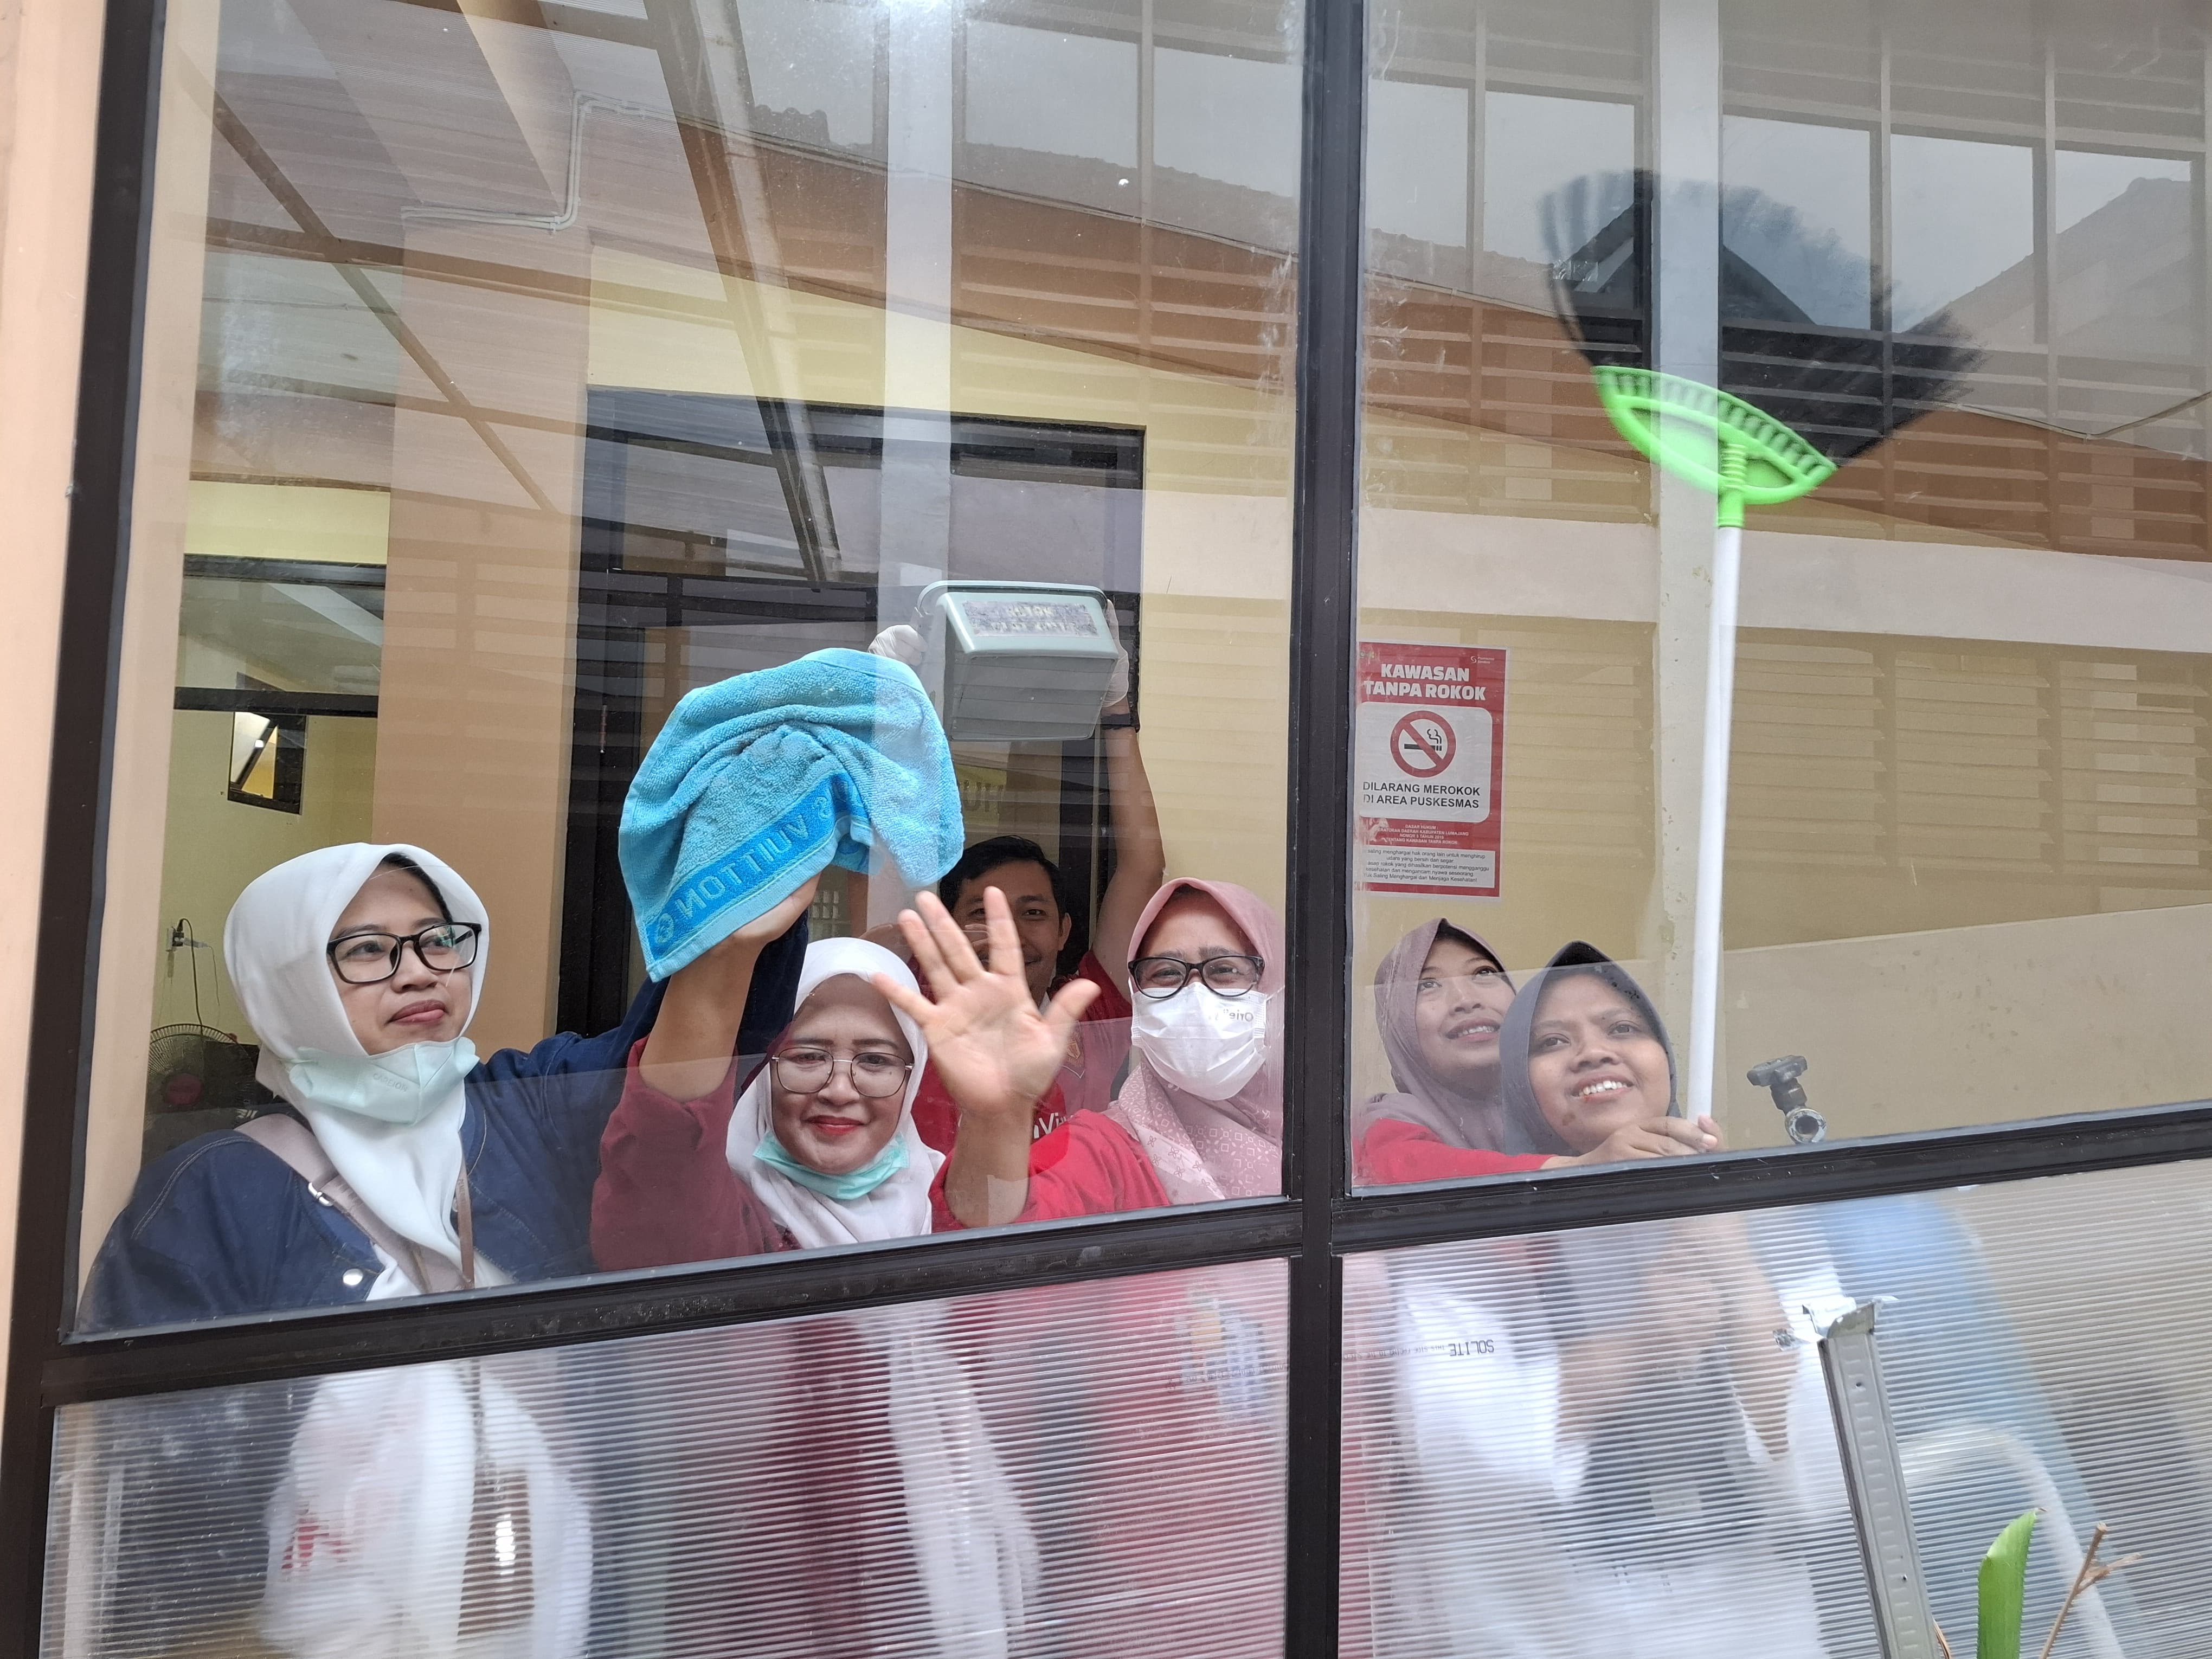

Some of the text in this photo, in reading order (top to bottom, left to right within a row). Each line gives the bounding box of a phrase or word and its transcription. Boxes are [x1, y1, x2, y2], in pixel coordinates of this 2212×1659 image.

[1381, 664, 1469, 681] KAWASAN
[1364, 680, 1486, 700] TANPA ROKOK
[1363, 781, 1480, 796] DILARANG MEROKOK
[1363, 794, 1479, 808] DI AREA PUSKESMAS
[1448, 1339, 1494, 1356] SOLITE
